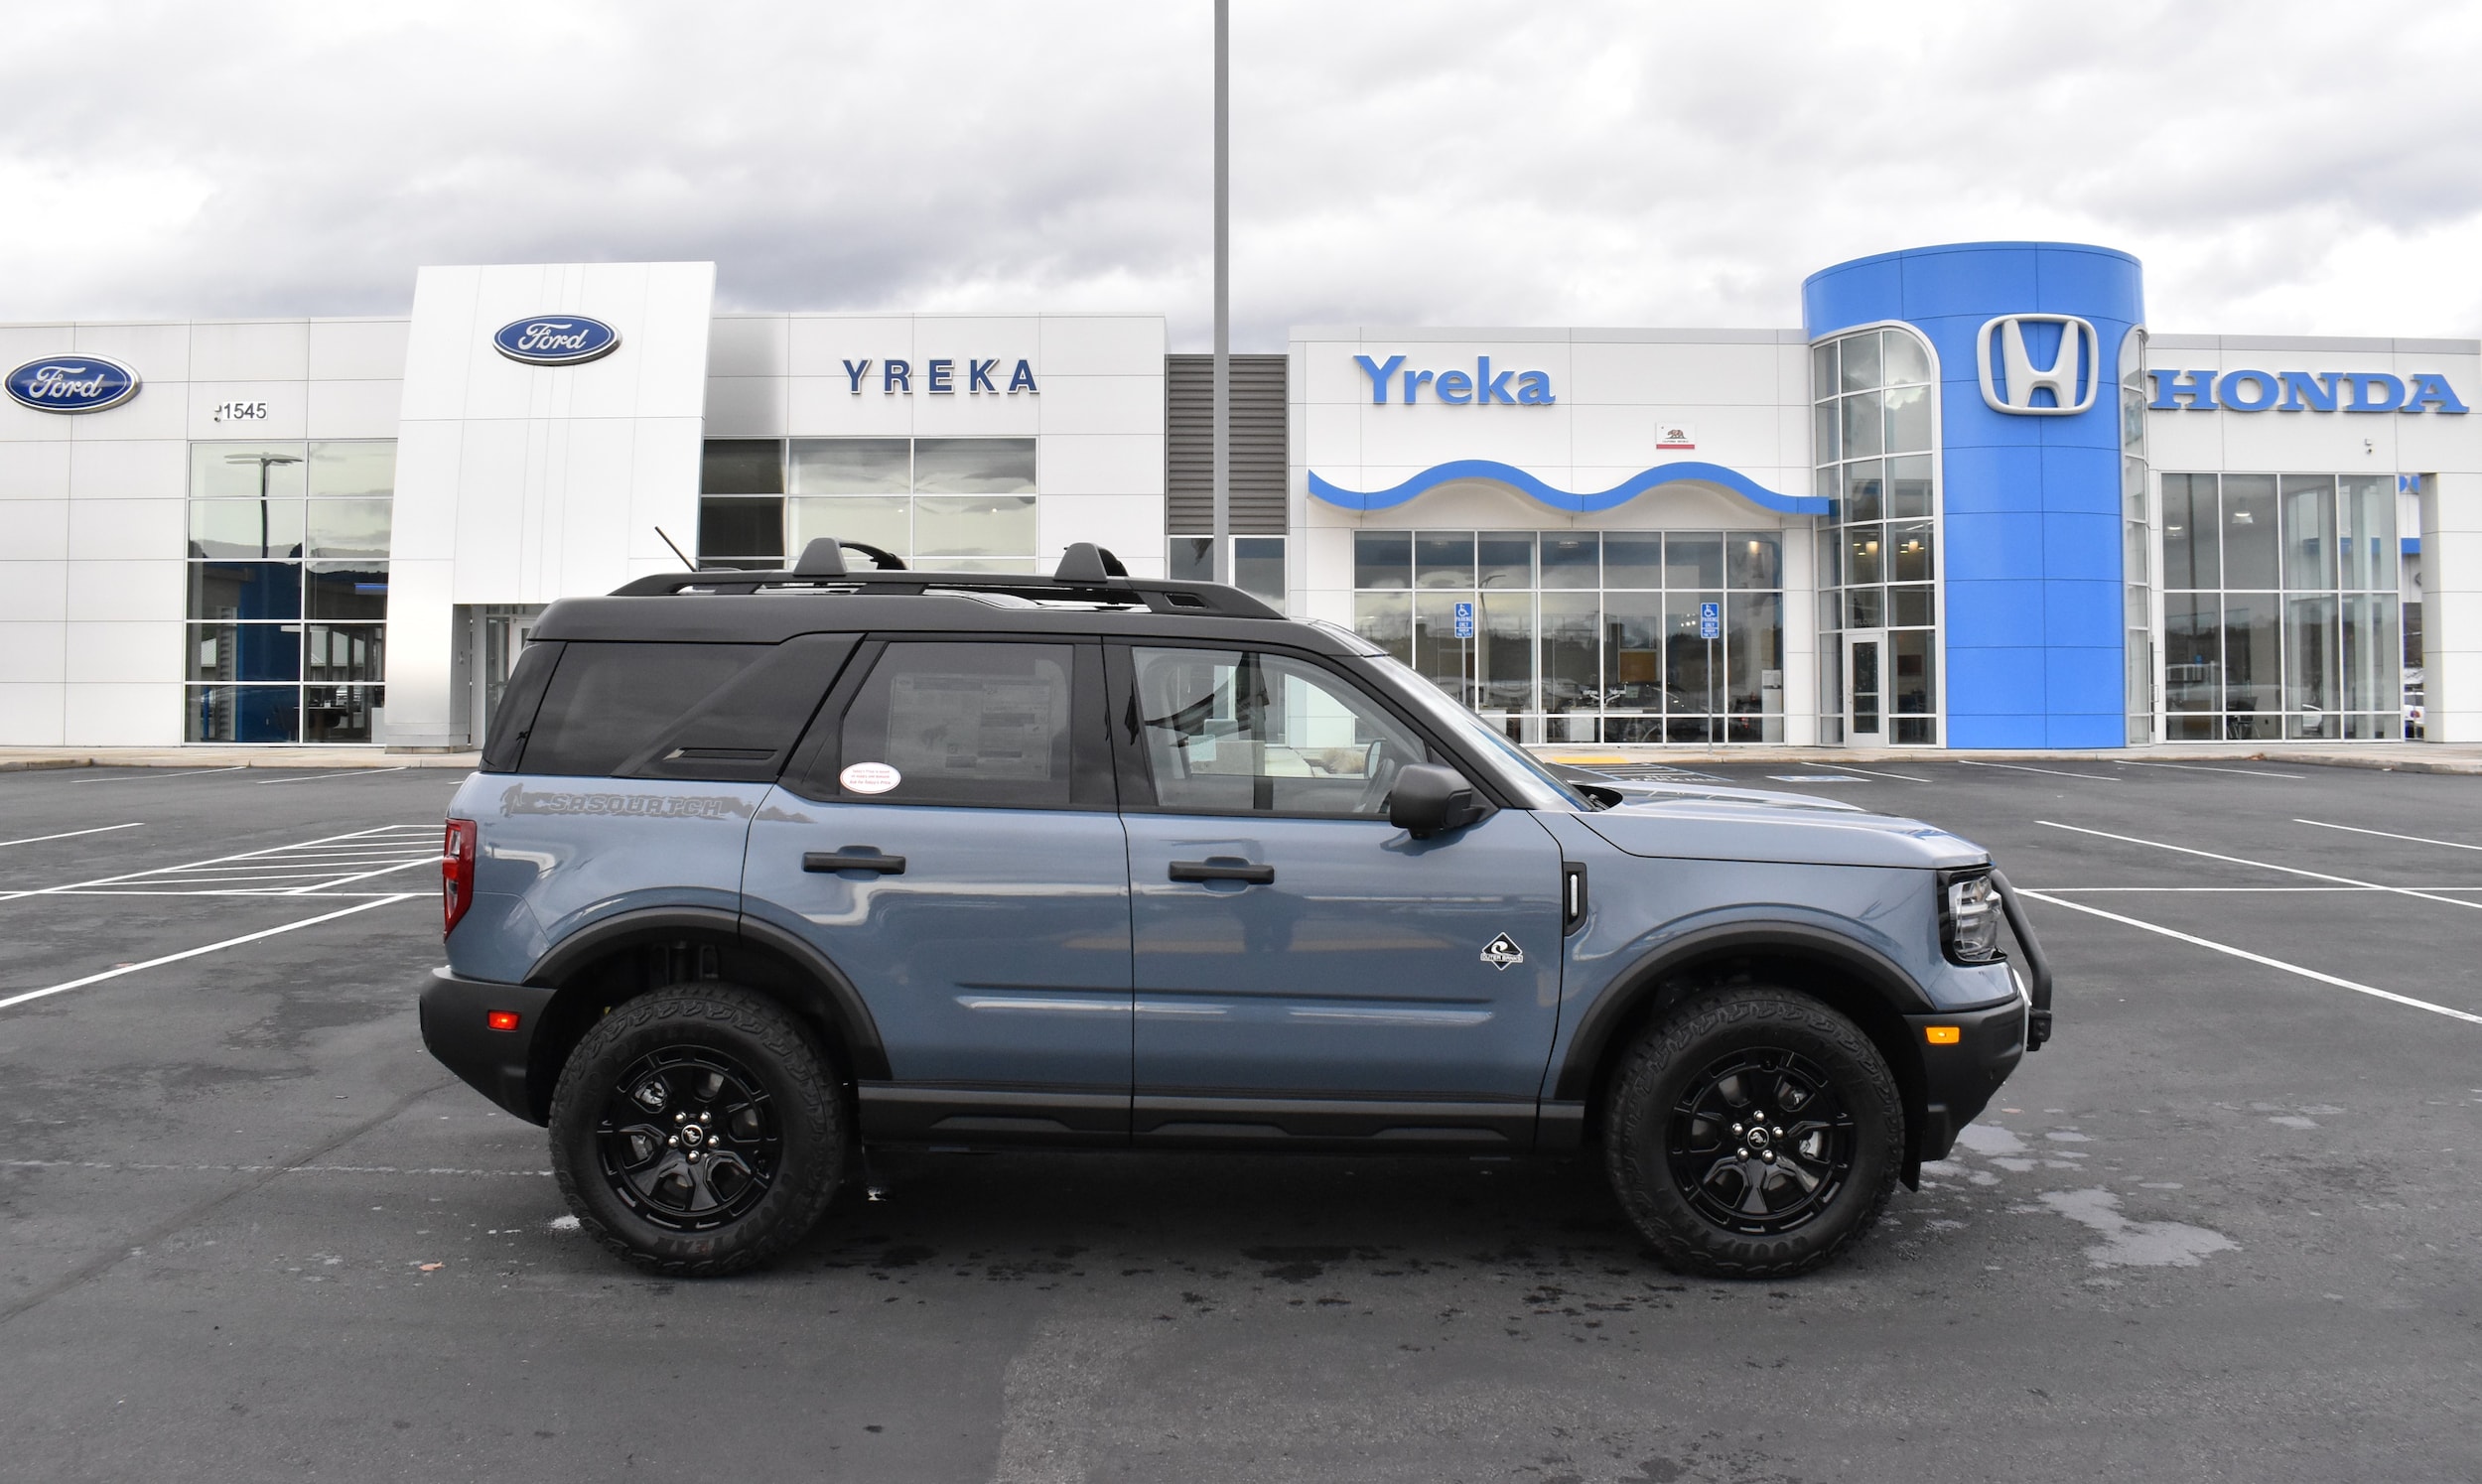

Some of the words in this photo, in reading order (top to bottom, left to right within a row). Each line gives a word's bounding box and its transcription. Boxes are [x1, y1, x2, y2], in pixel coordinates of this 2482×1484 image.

[517, 323, 590, 350] Ford
[28, 365, 105, 398] Ford
[842, 358, 1040, 394] YREKA
[1353, 355, 1557, 405] Yreka
[2147, 369, 2470, 414] HONDA
[223, 402, 267, 419] 1545
[549, 794, 724, 817] SASQUATCH
